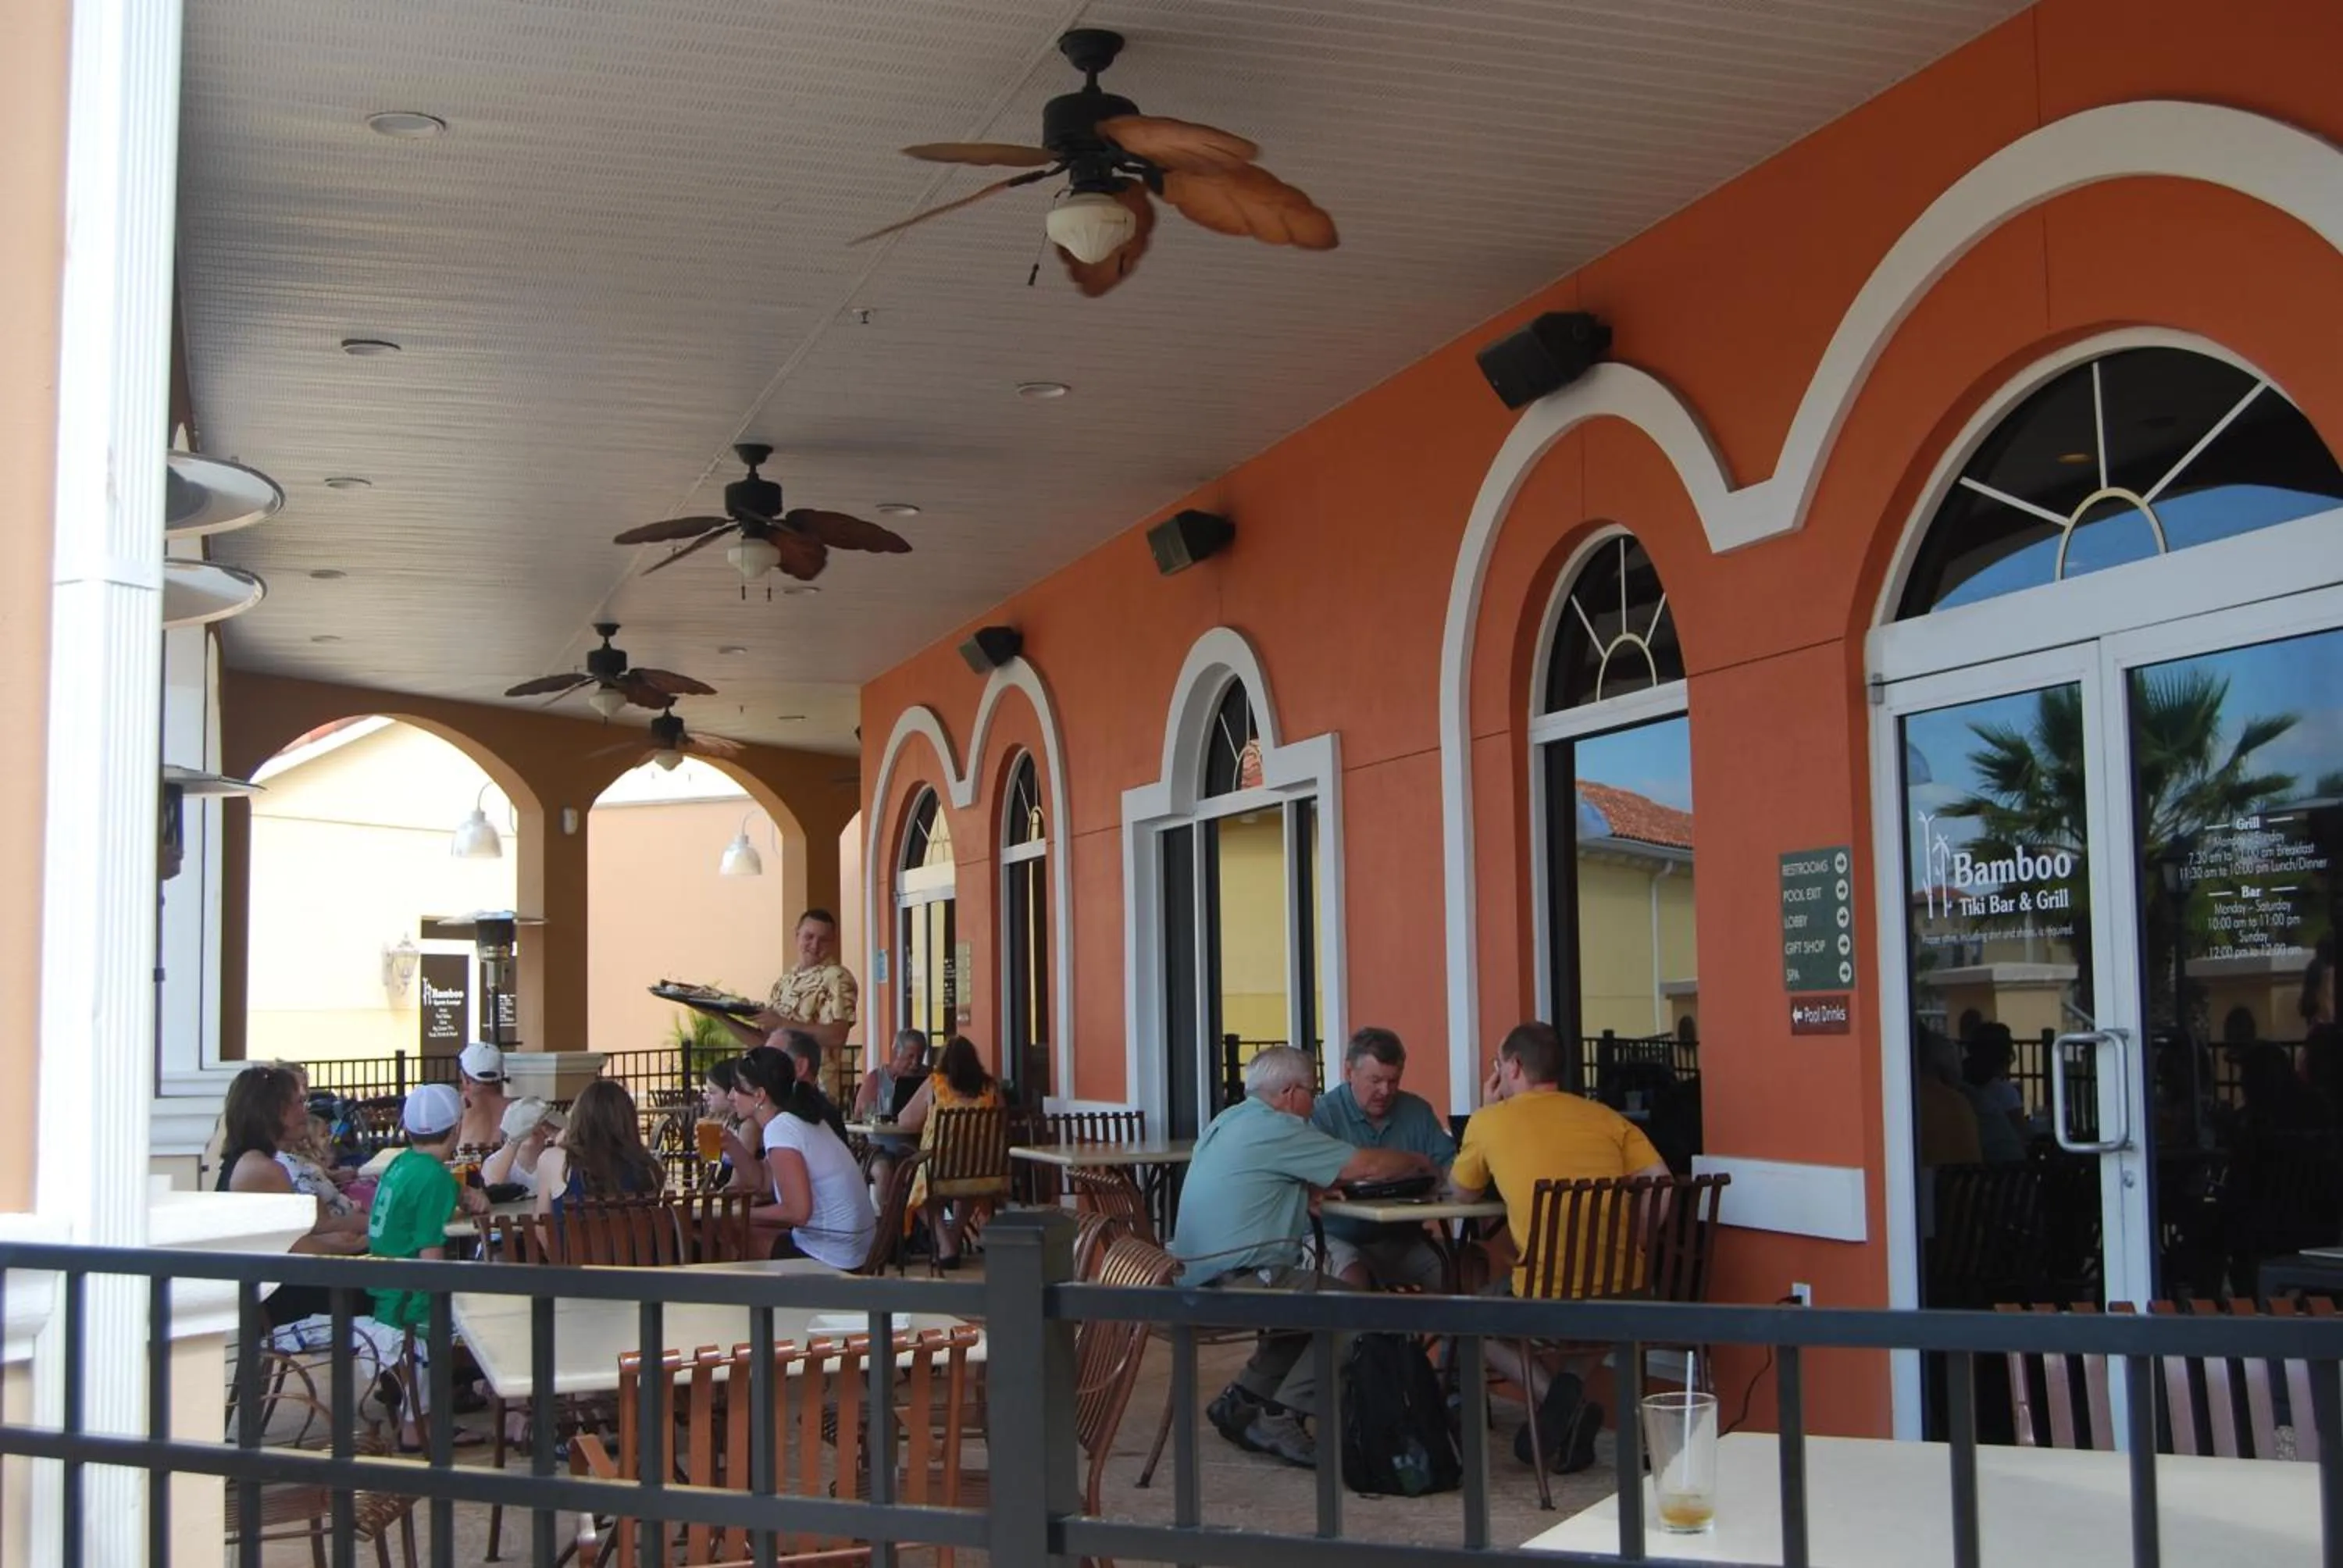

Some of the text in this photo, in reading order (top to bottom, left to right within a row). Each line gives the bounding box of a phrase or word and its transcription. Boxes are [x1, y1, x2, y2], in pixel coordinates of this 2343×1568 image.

[2236, 815, 2259, 830] Grill
[1953, 845, 2072, 888] Bamboo
[1783, 886, 1822, 903] POOL EXIT
[2241, 885, 2262, 899] Bar
[1960, 888, 2069, 917] Tiki Bar & Grill
[2214, 900, 2246, 916] Monday
[2255, 898, 2291, 913] Saturday
[1784, 914, 1809, 929] LOBBY
[2239, 928, 2268, 943] Sunday
[1785, 939, 1826, 956] GIFT SHOP
[1786, 968, 1800, 982] SPA
[1803, 1004, 1846, 1023] Pool Drinks
